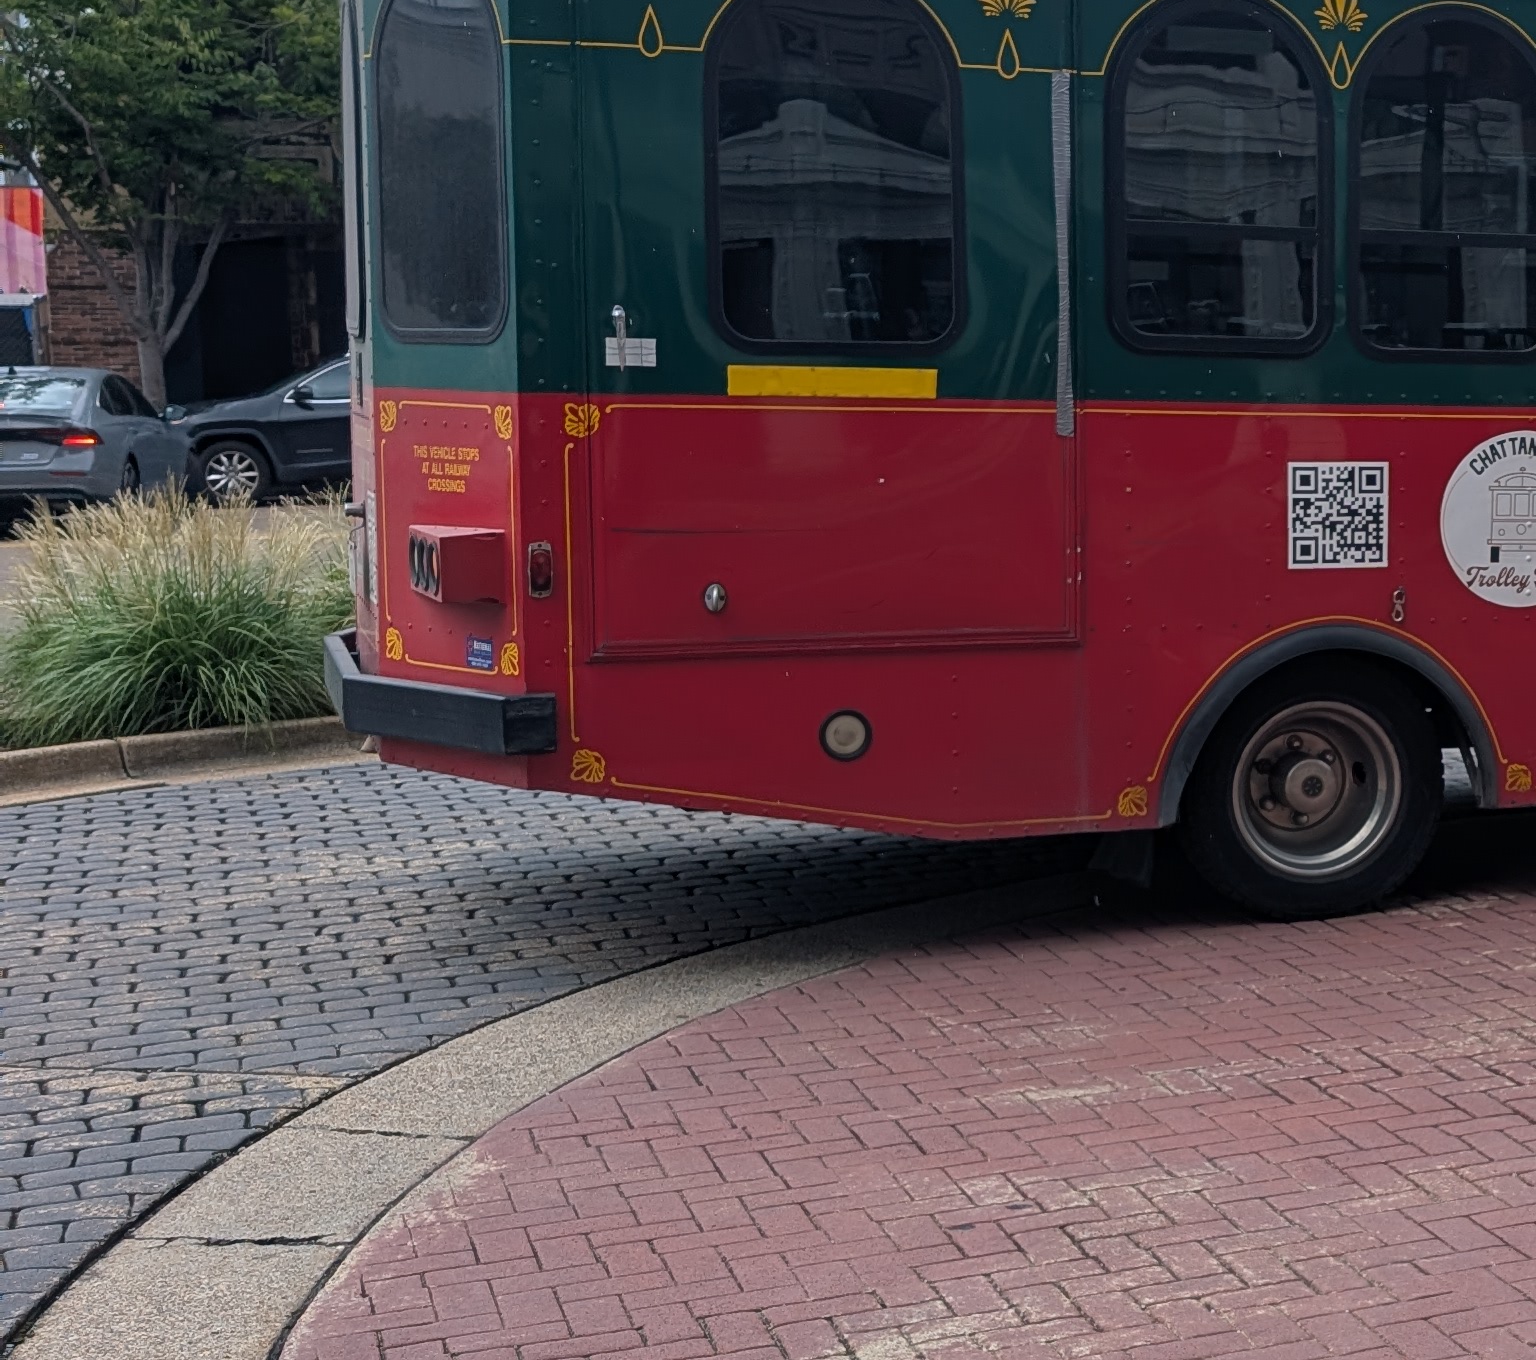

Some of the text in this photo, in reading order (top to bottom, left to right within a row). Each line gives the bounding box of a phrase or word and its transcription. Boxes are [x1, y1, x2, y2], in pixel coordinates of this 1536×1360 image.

[413, 445, 479, 461] THIS VEHICLE STOPS
[422, 462, 429, 474] AT
[431, 463, 443, 475] ALL
[428, 478, 466, 493] CROSSINGS
[1466, 566, 1531, 594] Trolley
